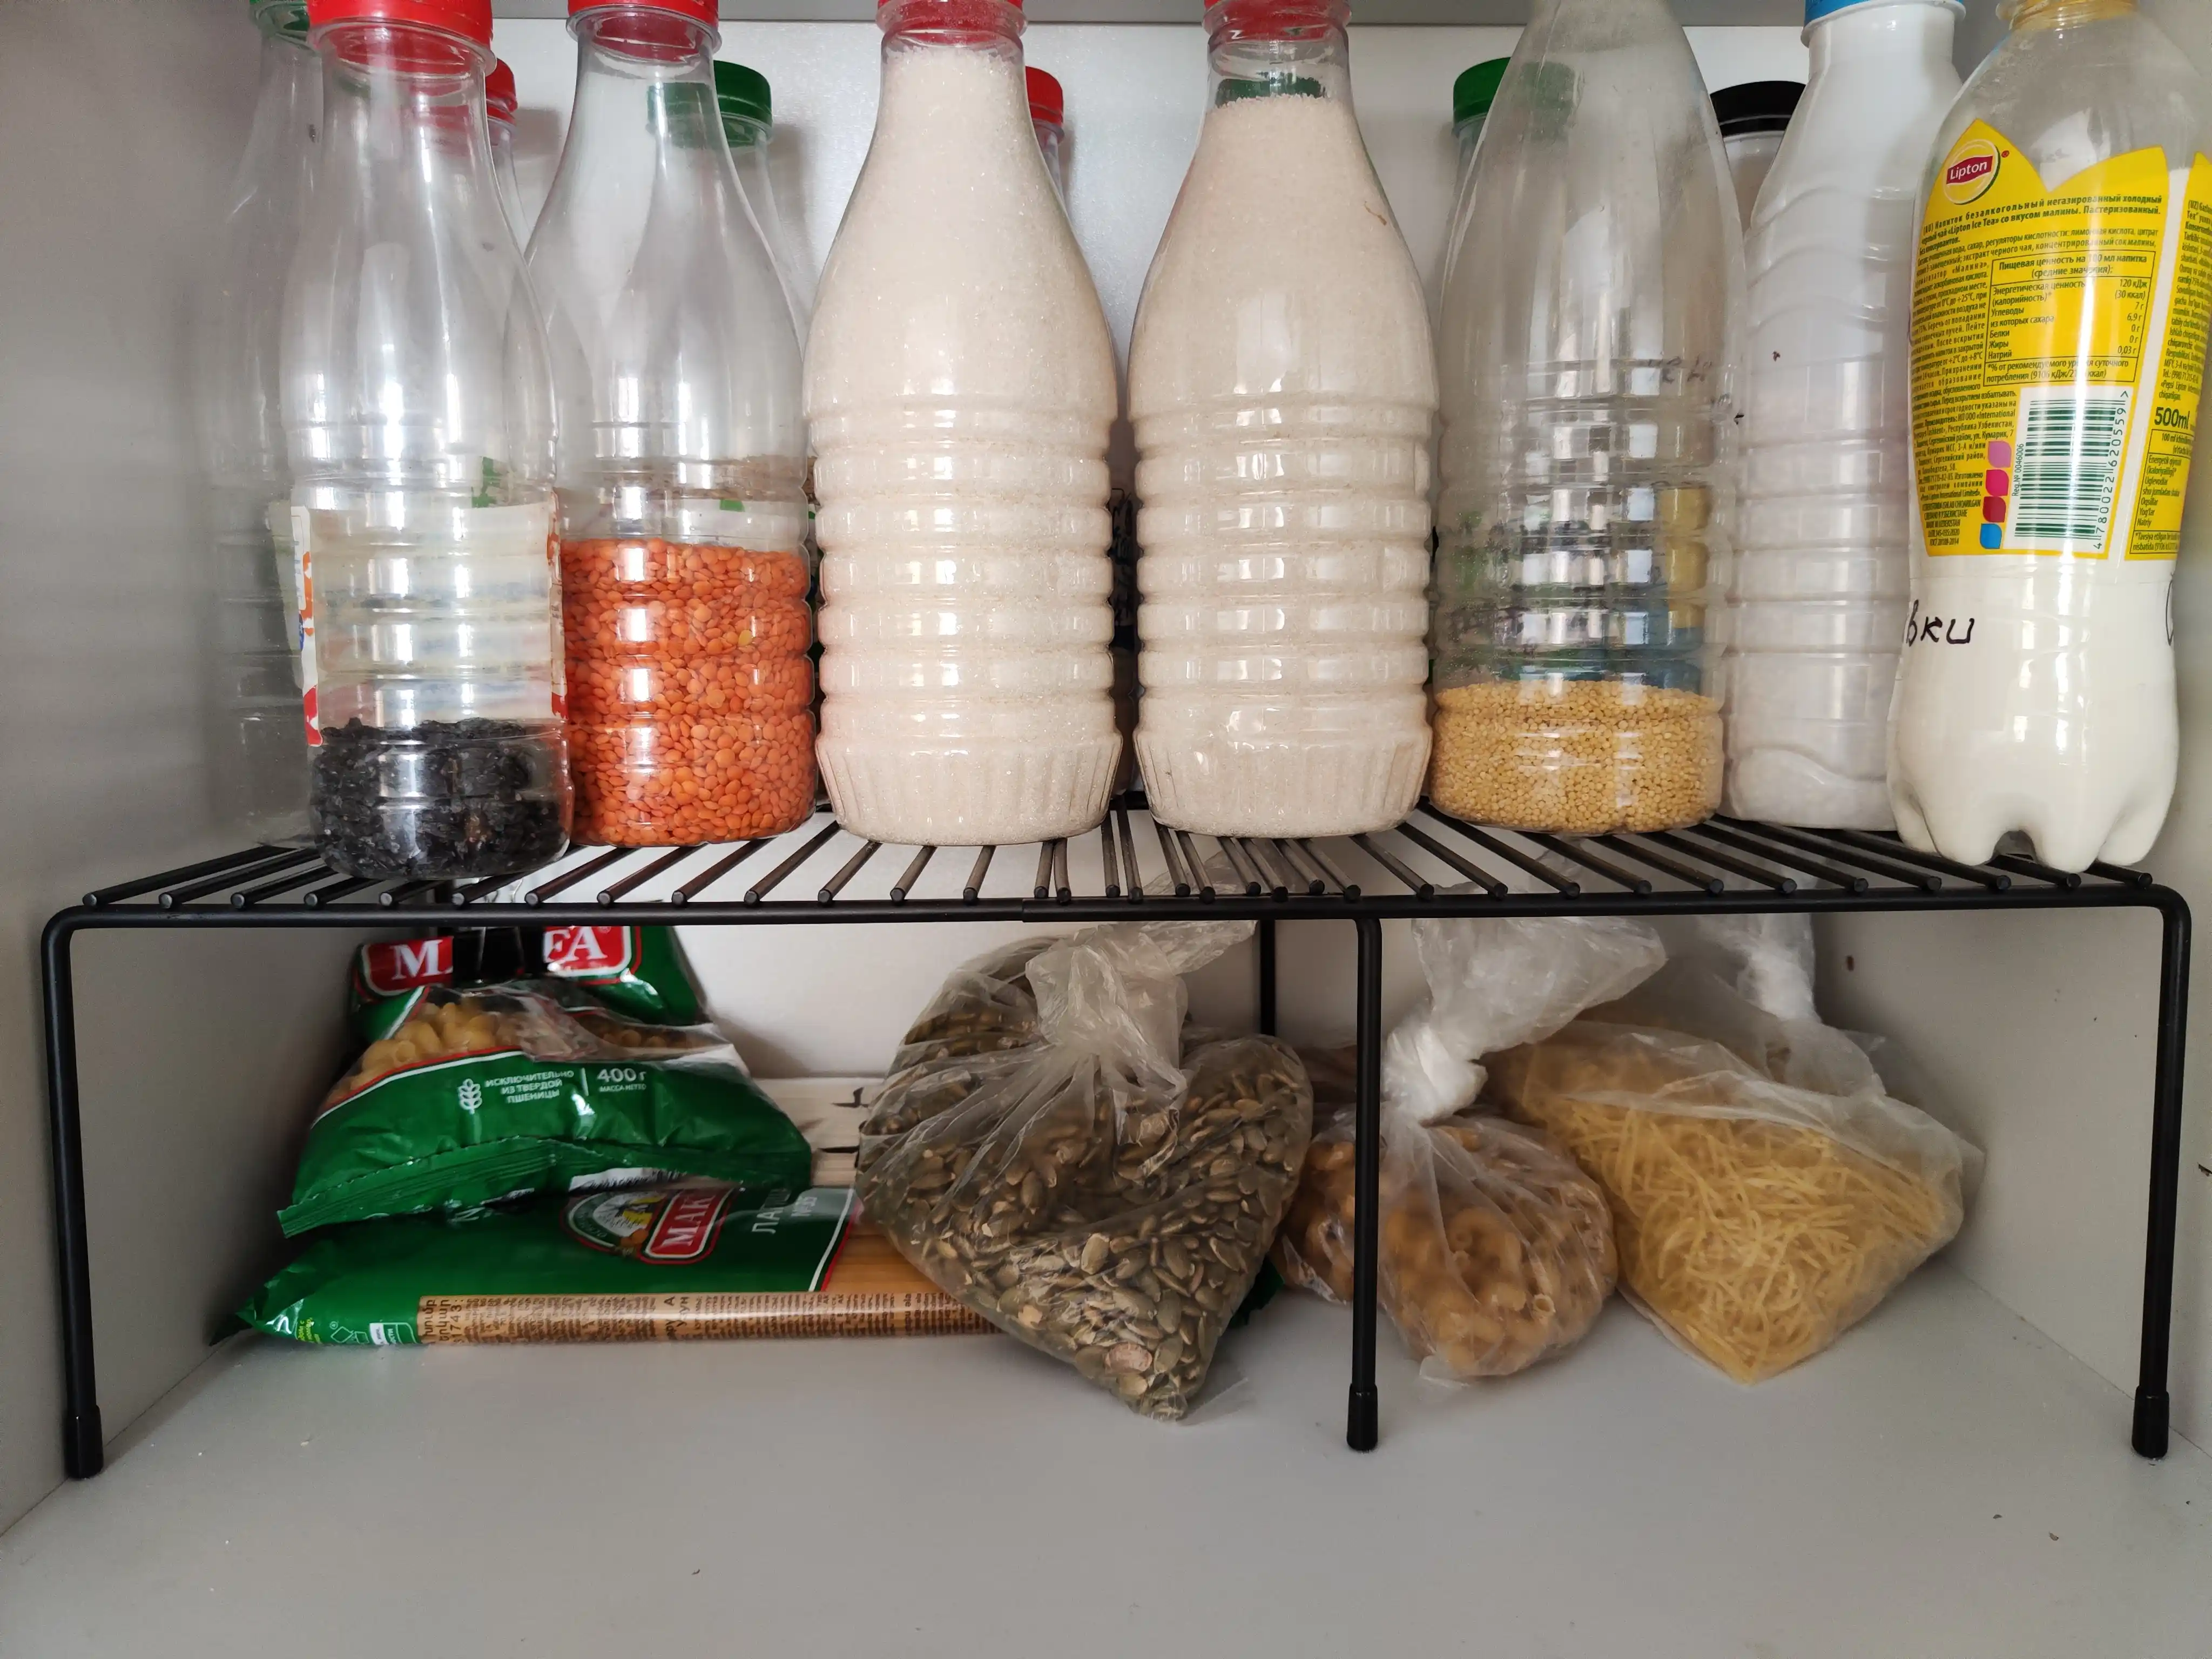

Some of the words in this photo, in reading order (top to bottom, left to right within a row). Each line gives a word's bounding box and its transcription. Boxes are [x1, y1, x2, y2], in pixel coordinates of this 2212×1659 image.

[1950, 161, 1987, 180] Lipton
[1965, 199, 2045, 220] безалкогольный
[2047, 194, 2121, 206] негазированный
[2123, 195, 2162, 204] холодный
[1972, 220, 1982, 229] Ice
[2011, 211, 2041, 223] вкусом
[2042, 206, 2081, 217] малины.
[2083, 205, 2161, 215] Пастеризованный.
[1986, 234, 2023, 247] регуляторы
[2137, 229, 2159, 238] цитрат
[1963, 250, 1990, 262] экстракт
[1991, 245, 2018, 257] черного
[2128, 238, 2156, 247] малины,
[1999, 259, 2034, 271] Пищевая
[2036, 255, 2074, 267] ценность
[2075, 255, 2086, 263] на
[2116, 255, 2147, 263] напитка
[2032, 266, 2068, 280] (средние
[1969, 281, 1987, 290] месте,
[1993, 281, 2049, 296] Энергетическая
[2050, 280, 2086, 291] ценность
[2119, 278, 2132, 287] 120
[2132, 279, 2148, 289] кДж
[1975, 292, 1987, 301] при
[2115, 289, 2126, 300] (30
[2126, 290, 2146, 300] ккал)
[2134, 301, 2139, 310] 7
[1951, 312, 1986, 324] попадания
[1990, 307, 2025, 319] Углеводы
[2127, 312, 2138, 322] 6,9
[1990, 320, 1998, 328] из
[1999, 316, 2028, 327] которых
[2029, 315, 2054, 325] сахара
[1945, 325, 1964, 337] лучей.
[1966, 322, 1985, 332] Пейте
[1990, 329, 2010, 339] Белки
[2131, 323, 2136, 333] 0
[1936, 338, 1953, 348] После
[1953, 332, 1984, 343] вскрытия
[1988, 340, 2009, 350] Жиры
[2129, 335, 2134, 343] 0
[1957, 342, 1984, 354] закрытой
[2117, 346, 2132, 355] 0,03
[1988, 349, 2012, 361] Натрий
[1951, 363, 1982, 374] хранении
[2007, 359, 2066, 370] рекомендуемого
[2094, 360, 2129, 368] суточного
[1938, 373, 1981, 387] образование
[1986, 372, 2029, 383] потребления
[1981, 390, 2017, 399] взбалтывать.
[1956, 403, 1981, 413] годности
[1981, 401, 2008, 410] указаны
[2154, 407, 2190, 430] 500ml
[1947, 423, 1977, 434] Республика
[1978, 420, 2014, 430] Узбекистан,
[1968, 442, 1986, 450] и/или
[1966, 452, 1985, 461] район,
[2015, 443, 2025, 474] 0046006
[1953, 480, 1983, 489] компании
[2137, 517, 2152, 529] Natriy
[484, 1070, 575, 1088] ИСКЛЮЧИТЕЛЬНО
[597, 1067, 637, 1083] 400
[639, 1070, 647, 1081] г
[501, 1085, 516, 1095] ИЗ
[517, 1078, 563, 1092] ТВЕРДОЙ
[507, 1089, 561, 1104] ПШЕНИЦЫ
[662, 1194, 716, 1247] MAK
